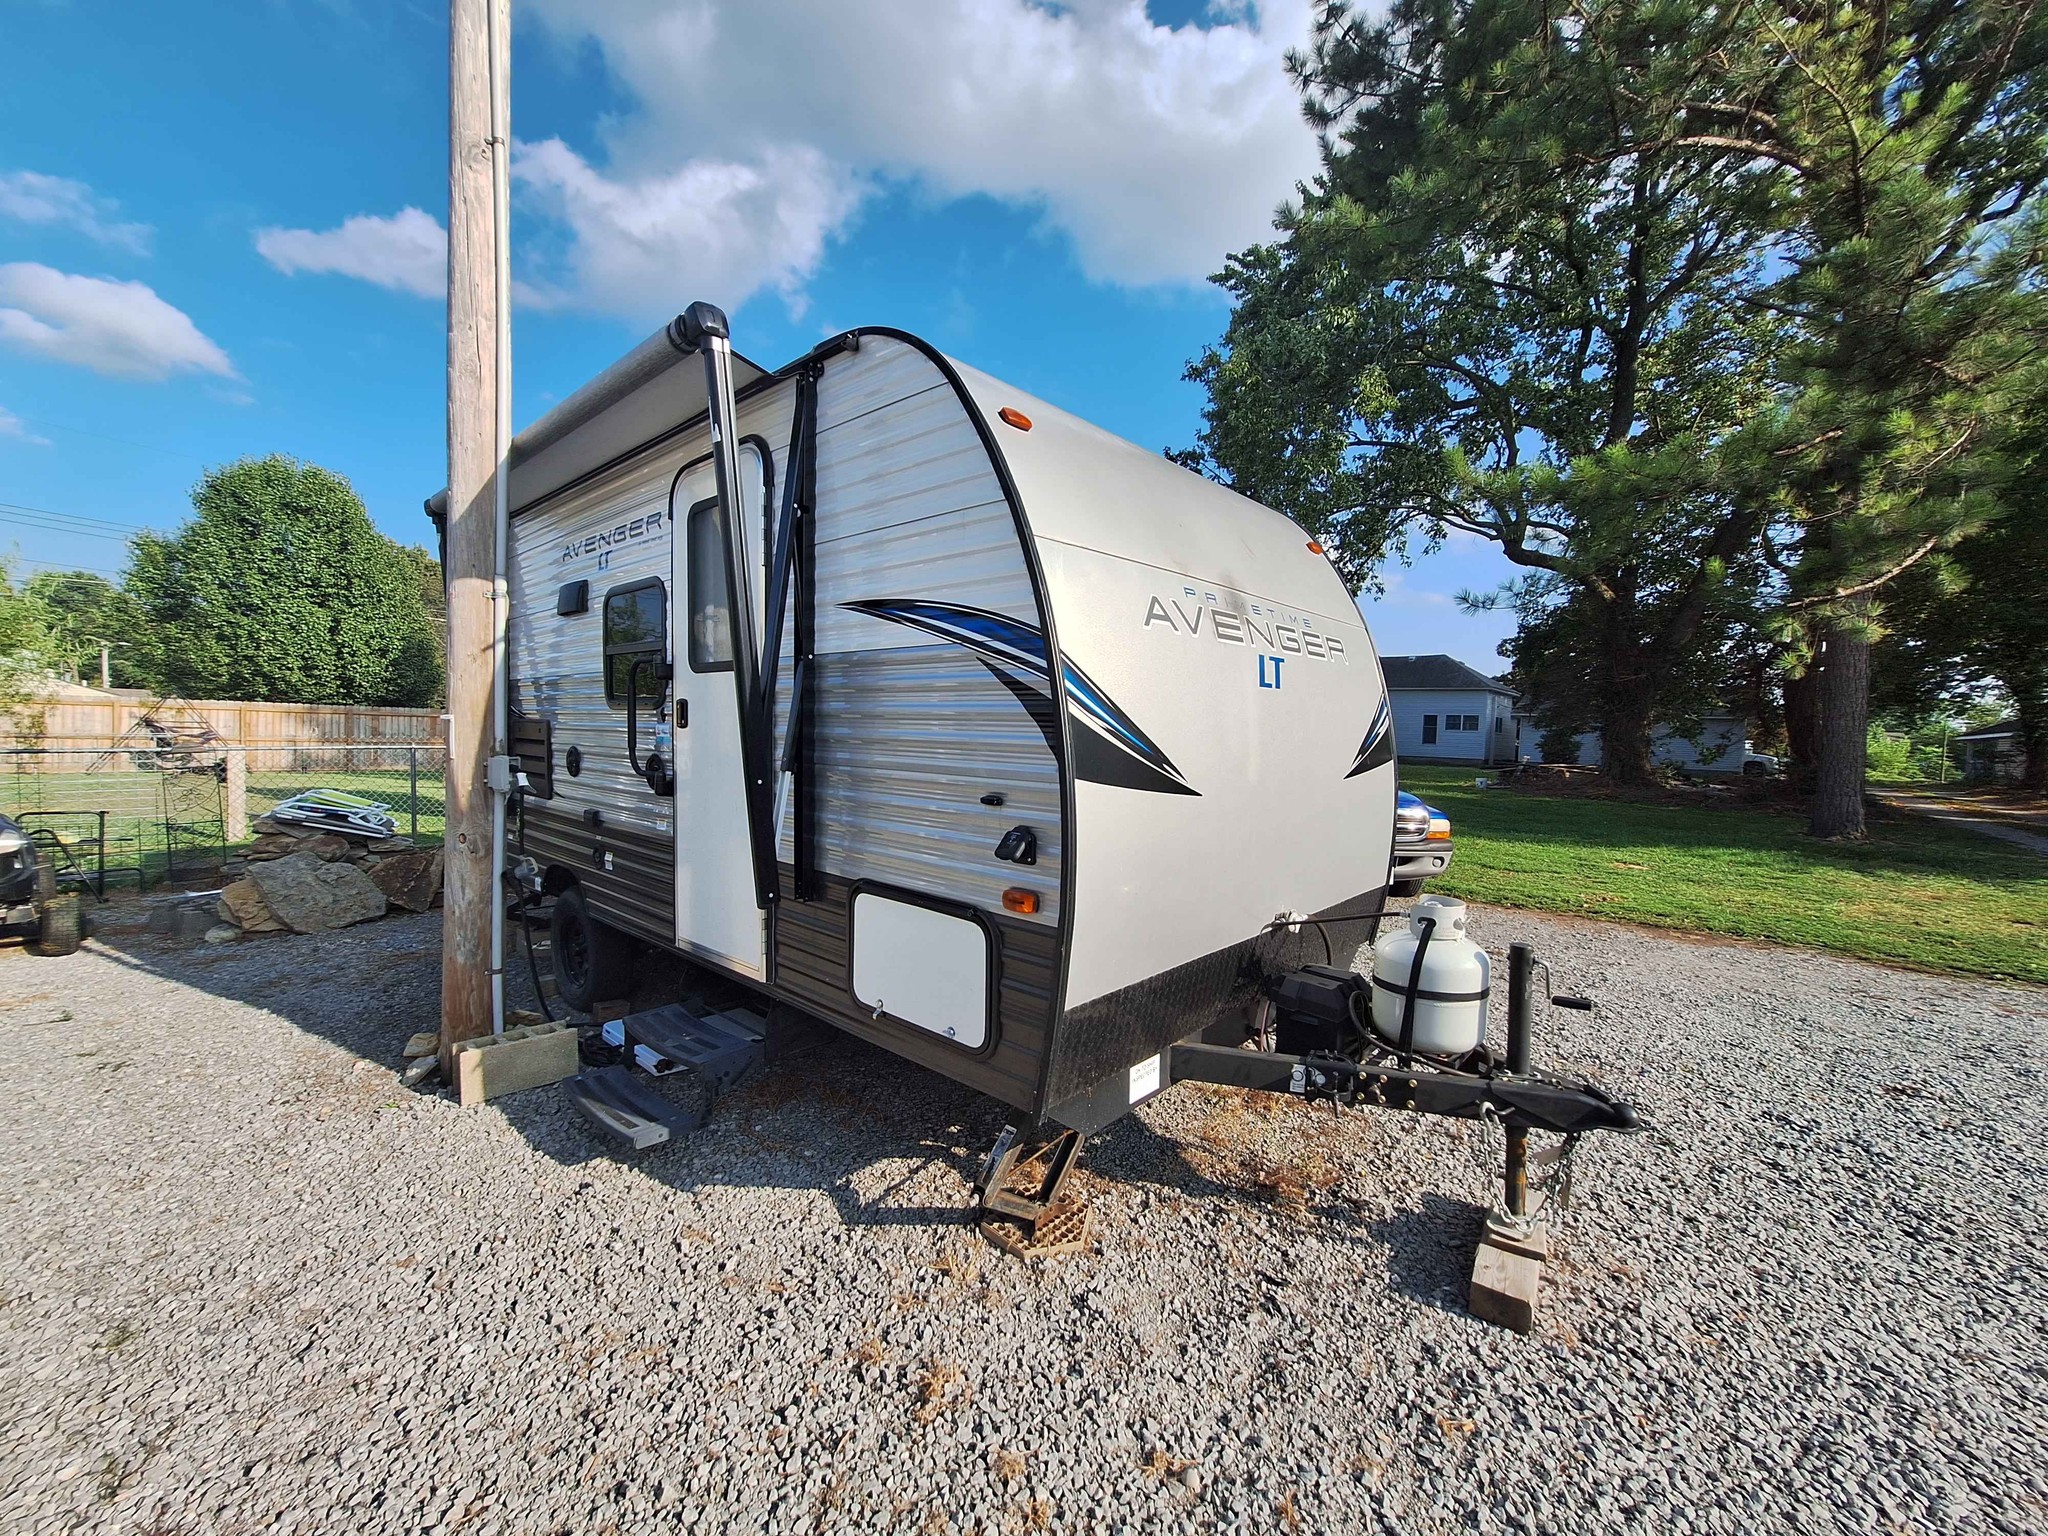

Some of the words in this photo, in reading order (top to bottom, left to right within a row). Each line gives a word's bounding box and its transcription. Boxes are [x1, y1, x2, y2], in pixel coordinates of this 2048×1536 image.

[562, 511, 662, 562] AVENGER
[598, 550, 613, 571] LT
[1143, 594, 1348, 665] AVENGER
[1258, 654, 1285, 689] LT
